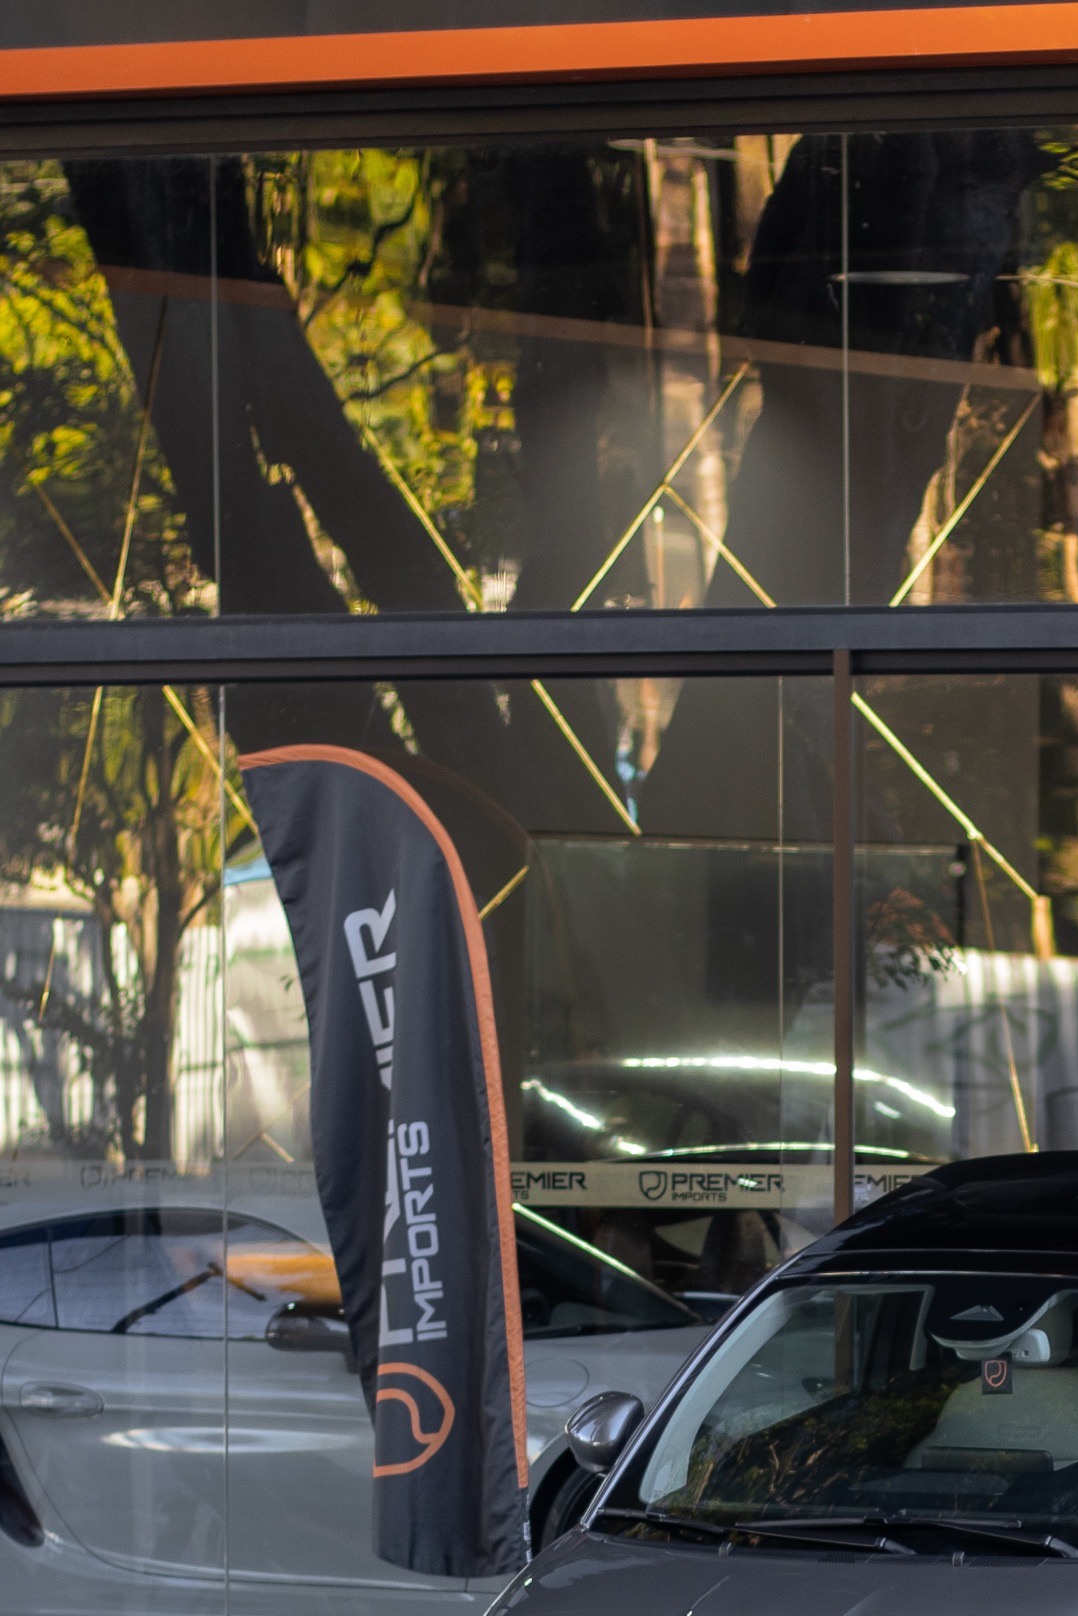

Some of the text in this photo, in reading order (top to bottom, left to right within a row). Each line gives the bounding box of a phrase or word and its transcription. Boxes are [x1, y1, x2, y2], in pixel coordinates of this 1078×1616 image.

[511, 1171, 588, 1190] EMIER
[671, 1192, 727, 1201] IMPORTS
[397, 1121, 448, 1342] IMPORTS
